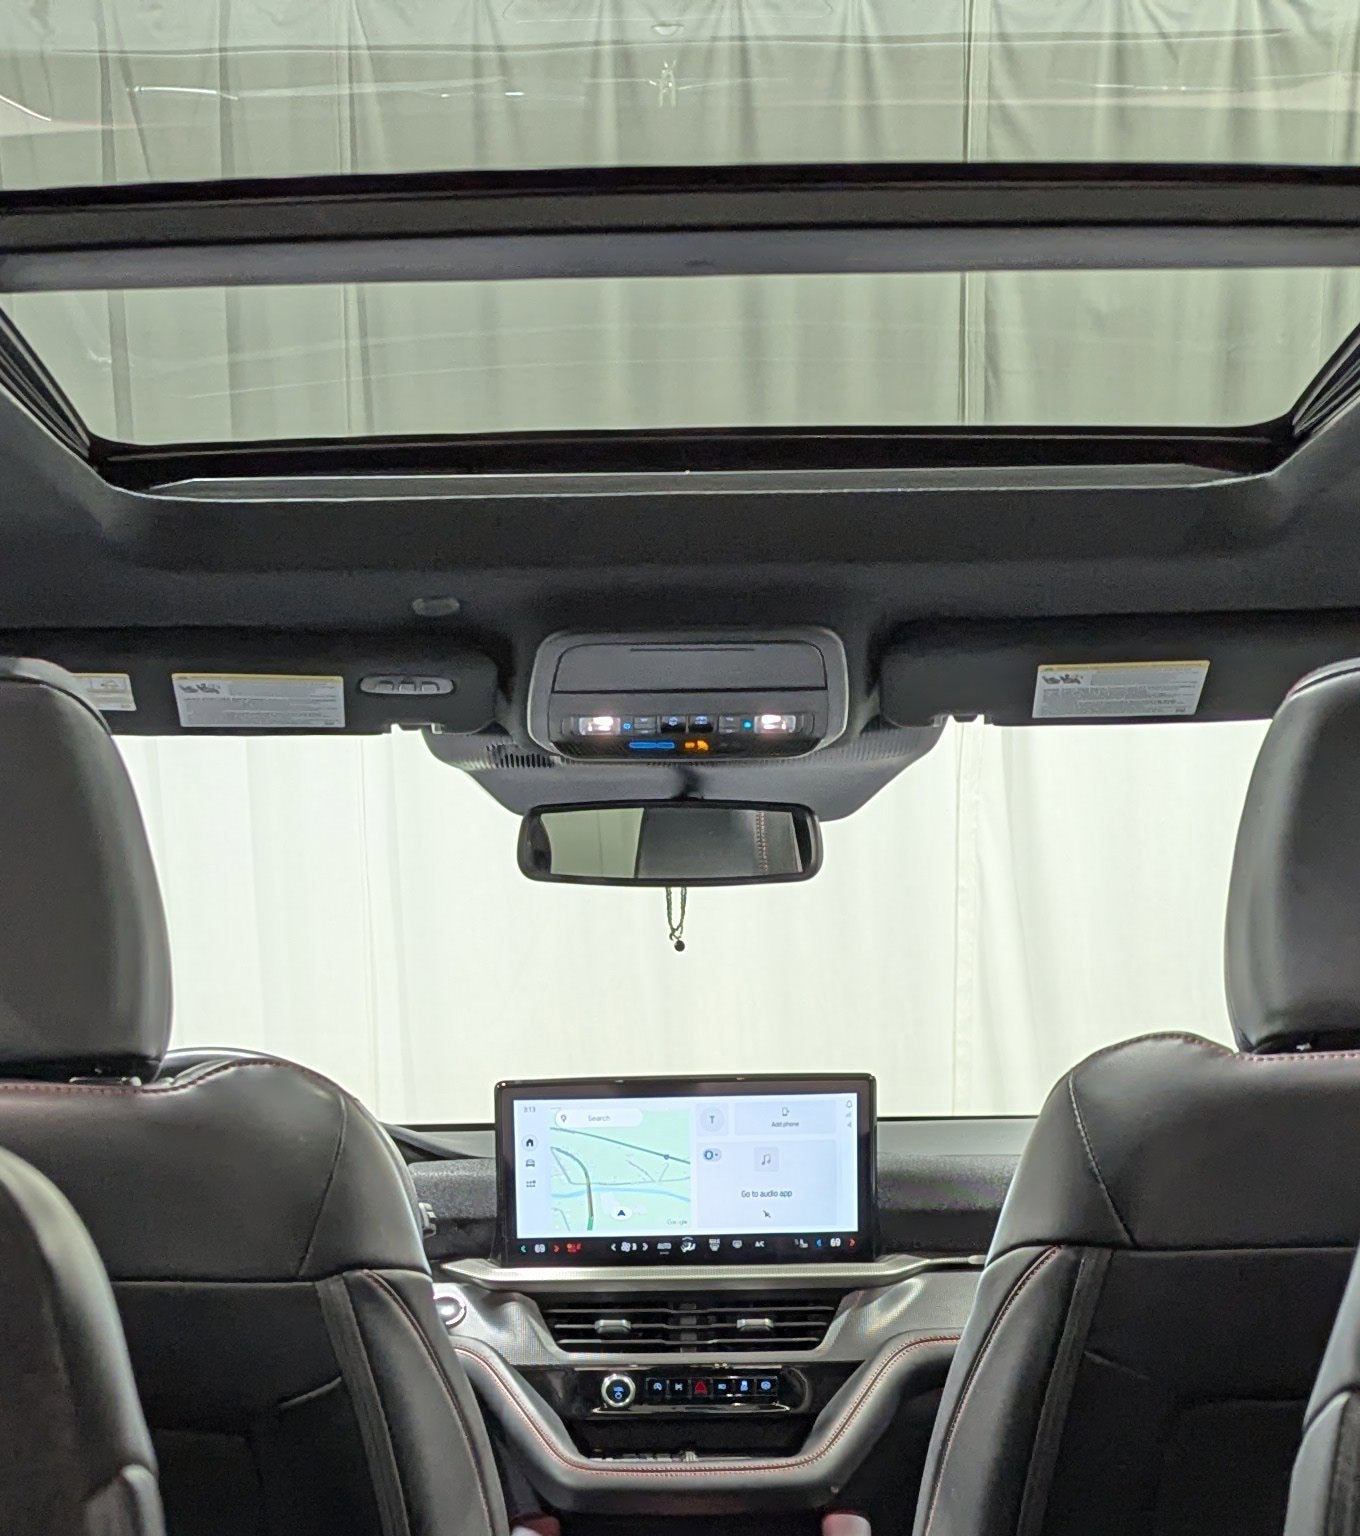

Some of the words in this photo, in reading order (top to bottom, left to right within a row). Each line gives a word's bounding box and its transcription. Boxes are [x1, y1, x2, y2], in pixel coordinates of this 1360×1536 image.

[588, 1114, 611, 1122] Search
[741, 1190, 751, 1198] Go
[752, 1190, 758, 1198] to
[759, 1190, 778, 1198] audio
[779, 1190, 793, 1199] app
